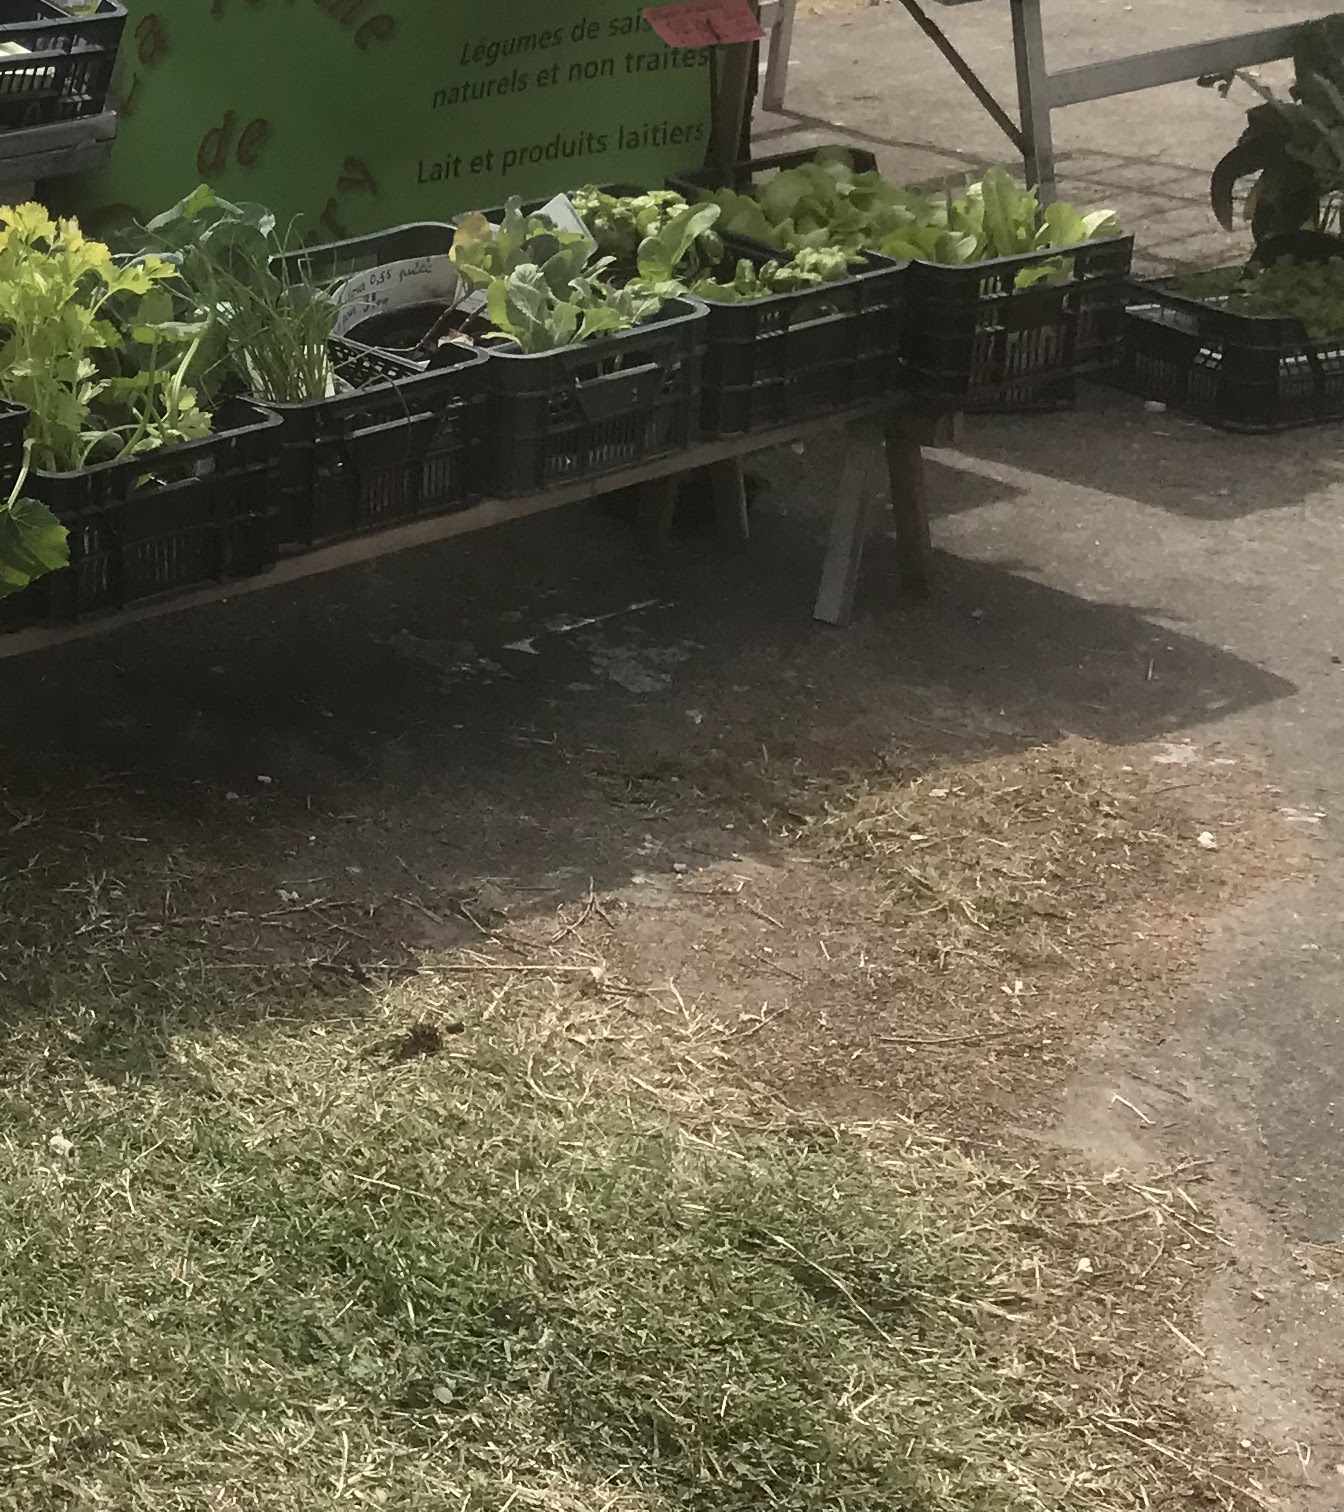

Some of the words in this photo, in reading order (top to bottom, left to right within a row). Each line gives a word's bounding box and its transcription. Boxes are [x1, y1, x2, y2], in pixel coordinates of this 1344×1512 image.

[570, 17, 601, 43] de
[608, 7, 654, 36] sais
[432, 68, 527, 110] naturels
[536, 63, 560, 89] et
[568, 57, 615, 82] non
[196, 109, 272, 177] de
[417, 153, 463, 185] Lait
[469, 150, 494, 173] et
[501, 130, 608, 176] produits
[618, 121, 706, 150] laitiers
